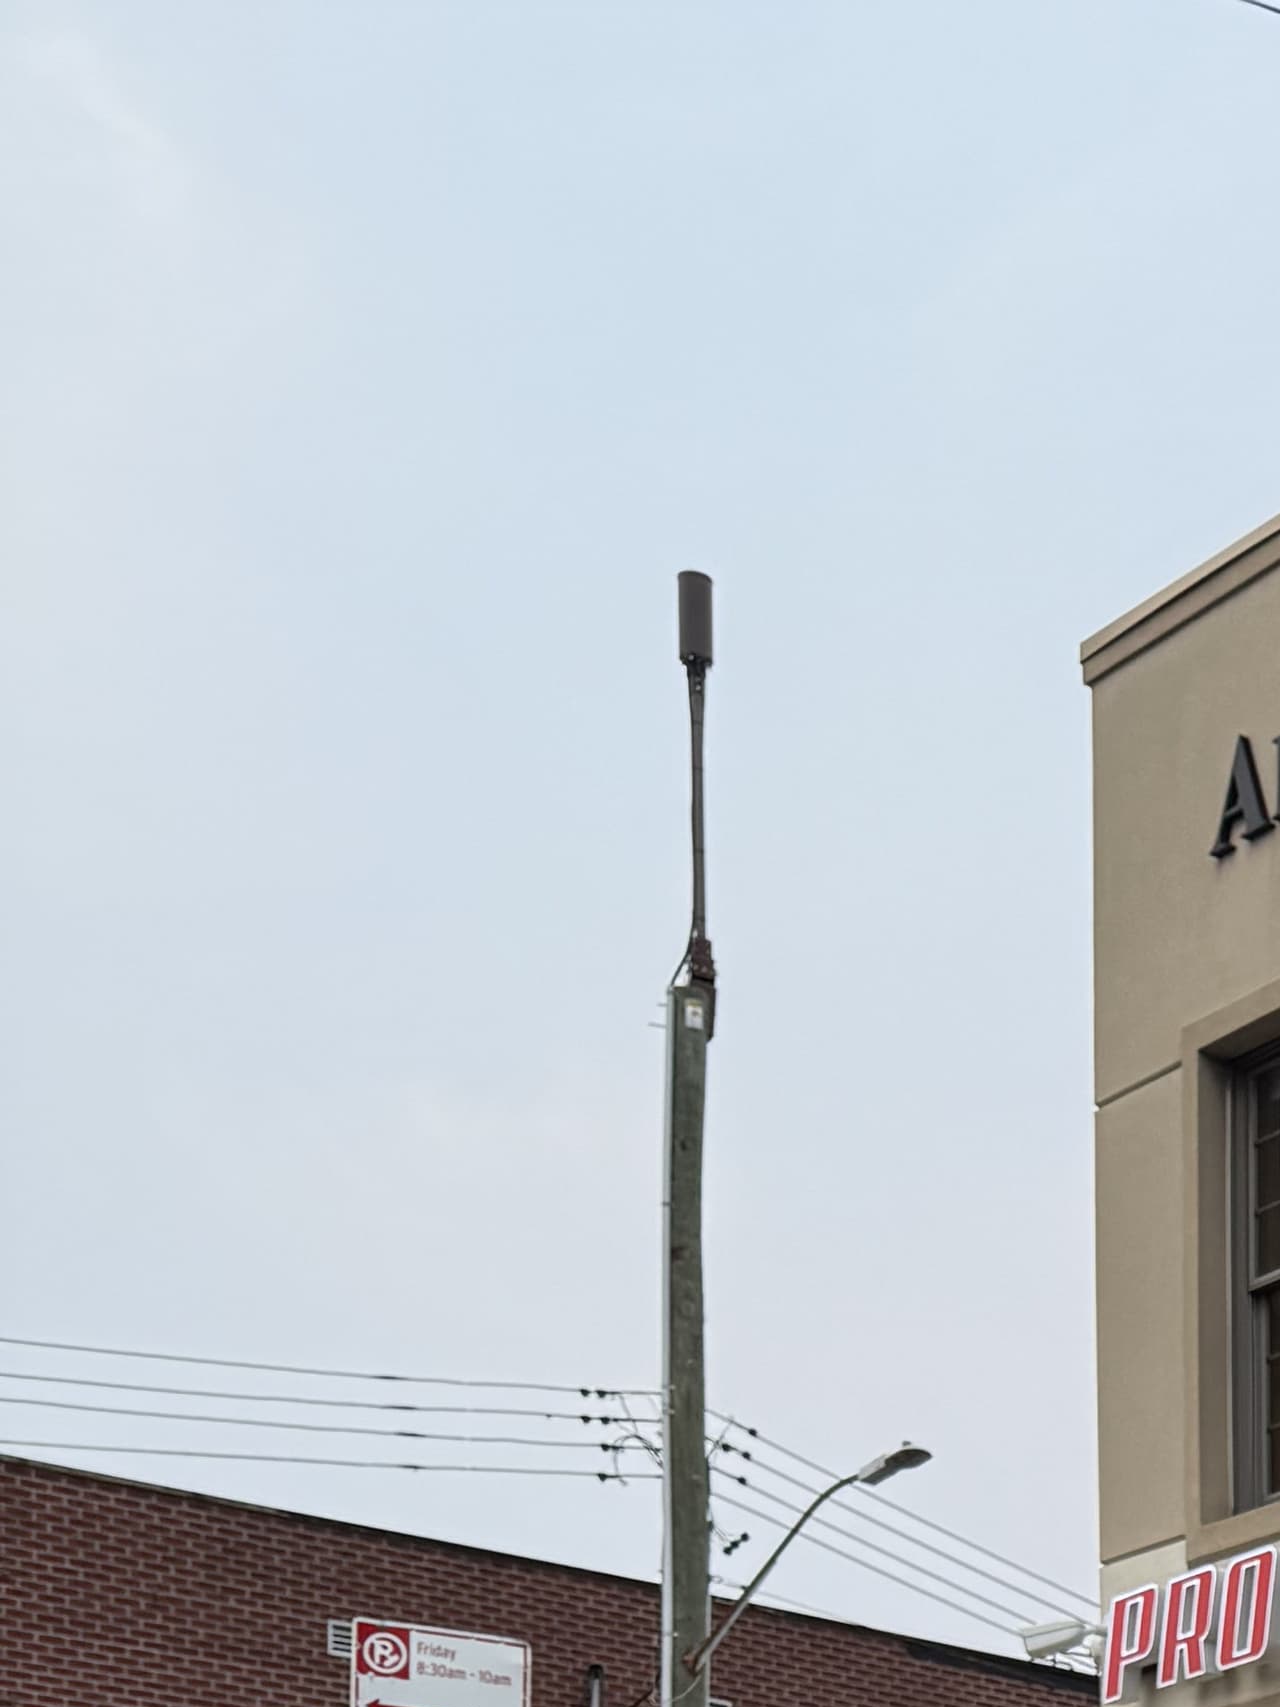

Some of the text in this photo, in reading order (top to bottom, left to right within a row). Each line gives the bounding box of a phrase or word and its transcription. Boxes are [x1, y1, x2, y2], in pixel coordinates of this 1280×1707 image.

[1103, 1544, 1280, 1704] PRO
[417, 1642, 456, 1662] Friday
[416, 1661, 467, 1680] 8:30am
[478, 1669, 512, 1686] 10am
